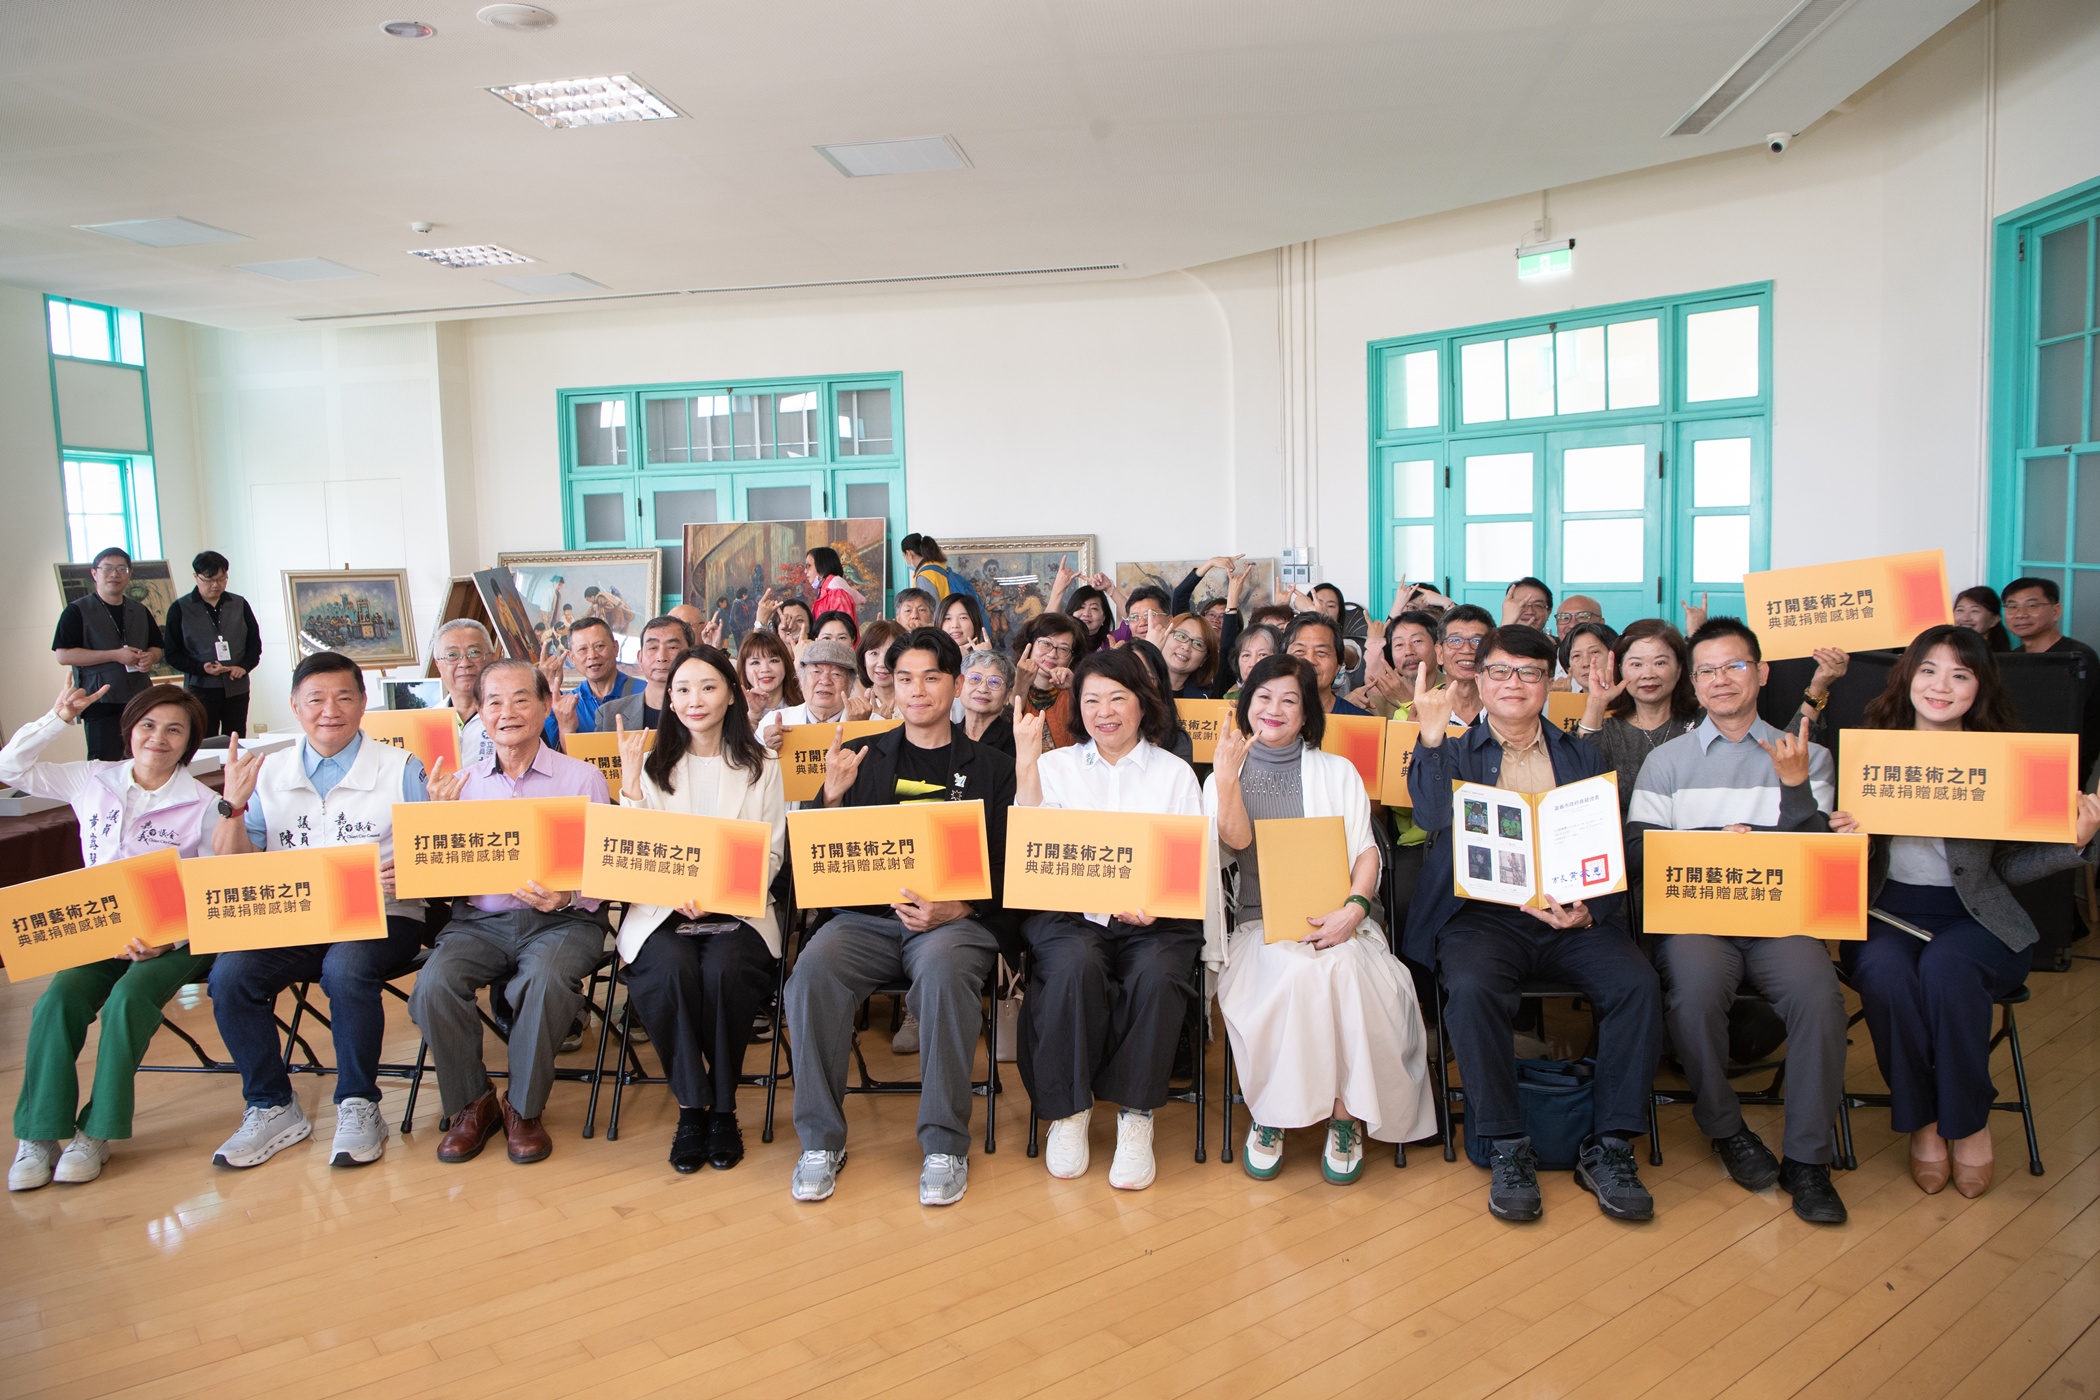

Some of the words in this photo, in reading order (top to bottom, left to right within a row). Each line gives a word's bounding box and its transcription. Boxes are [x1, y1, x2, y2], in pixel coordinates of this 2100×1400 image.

[1767, 590, 1873, 615] 打開藝術之門
[1768, 607, 1874, 628] 典藏捐贈感謝會
[1863, 765, 1987, 784] 打開藝術之門
[1862, 785, 1986, 801] 典藏捐贈感謝會
[297, 815, 311, 847] 議員
[414, 832, 520, 851] 打開藝術之門
[603, 838, 701, 862] 打開藝術之門
[810, 839, 915, 859] 打開藝術之門
[415, 848, 520, 864] 典藏捐贈感謝會
[1026, 842, 1133, 863] 打開藝術之門
[602, 855, 699, 876] 典藏捐贈感謝會
[812, 857, 915, 874] 典藏捐贈感謝會
[1025, 861, 1132, 878] 典藏捐贈感謝會
[1665, 866, 1783, 885] 打開藝術之門
[205, 882, 311, 905] 打開藝術之門
[1665, 885, 1783, 901] 典藏捐贈感謝會
[11, 895, 120, 933] 打開藝術之門
[207, 899, 311, 919] 典藏捐贈感謝會
[17, 912, 122, 947] 典藏捐贈感謝會
